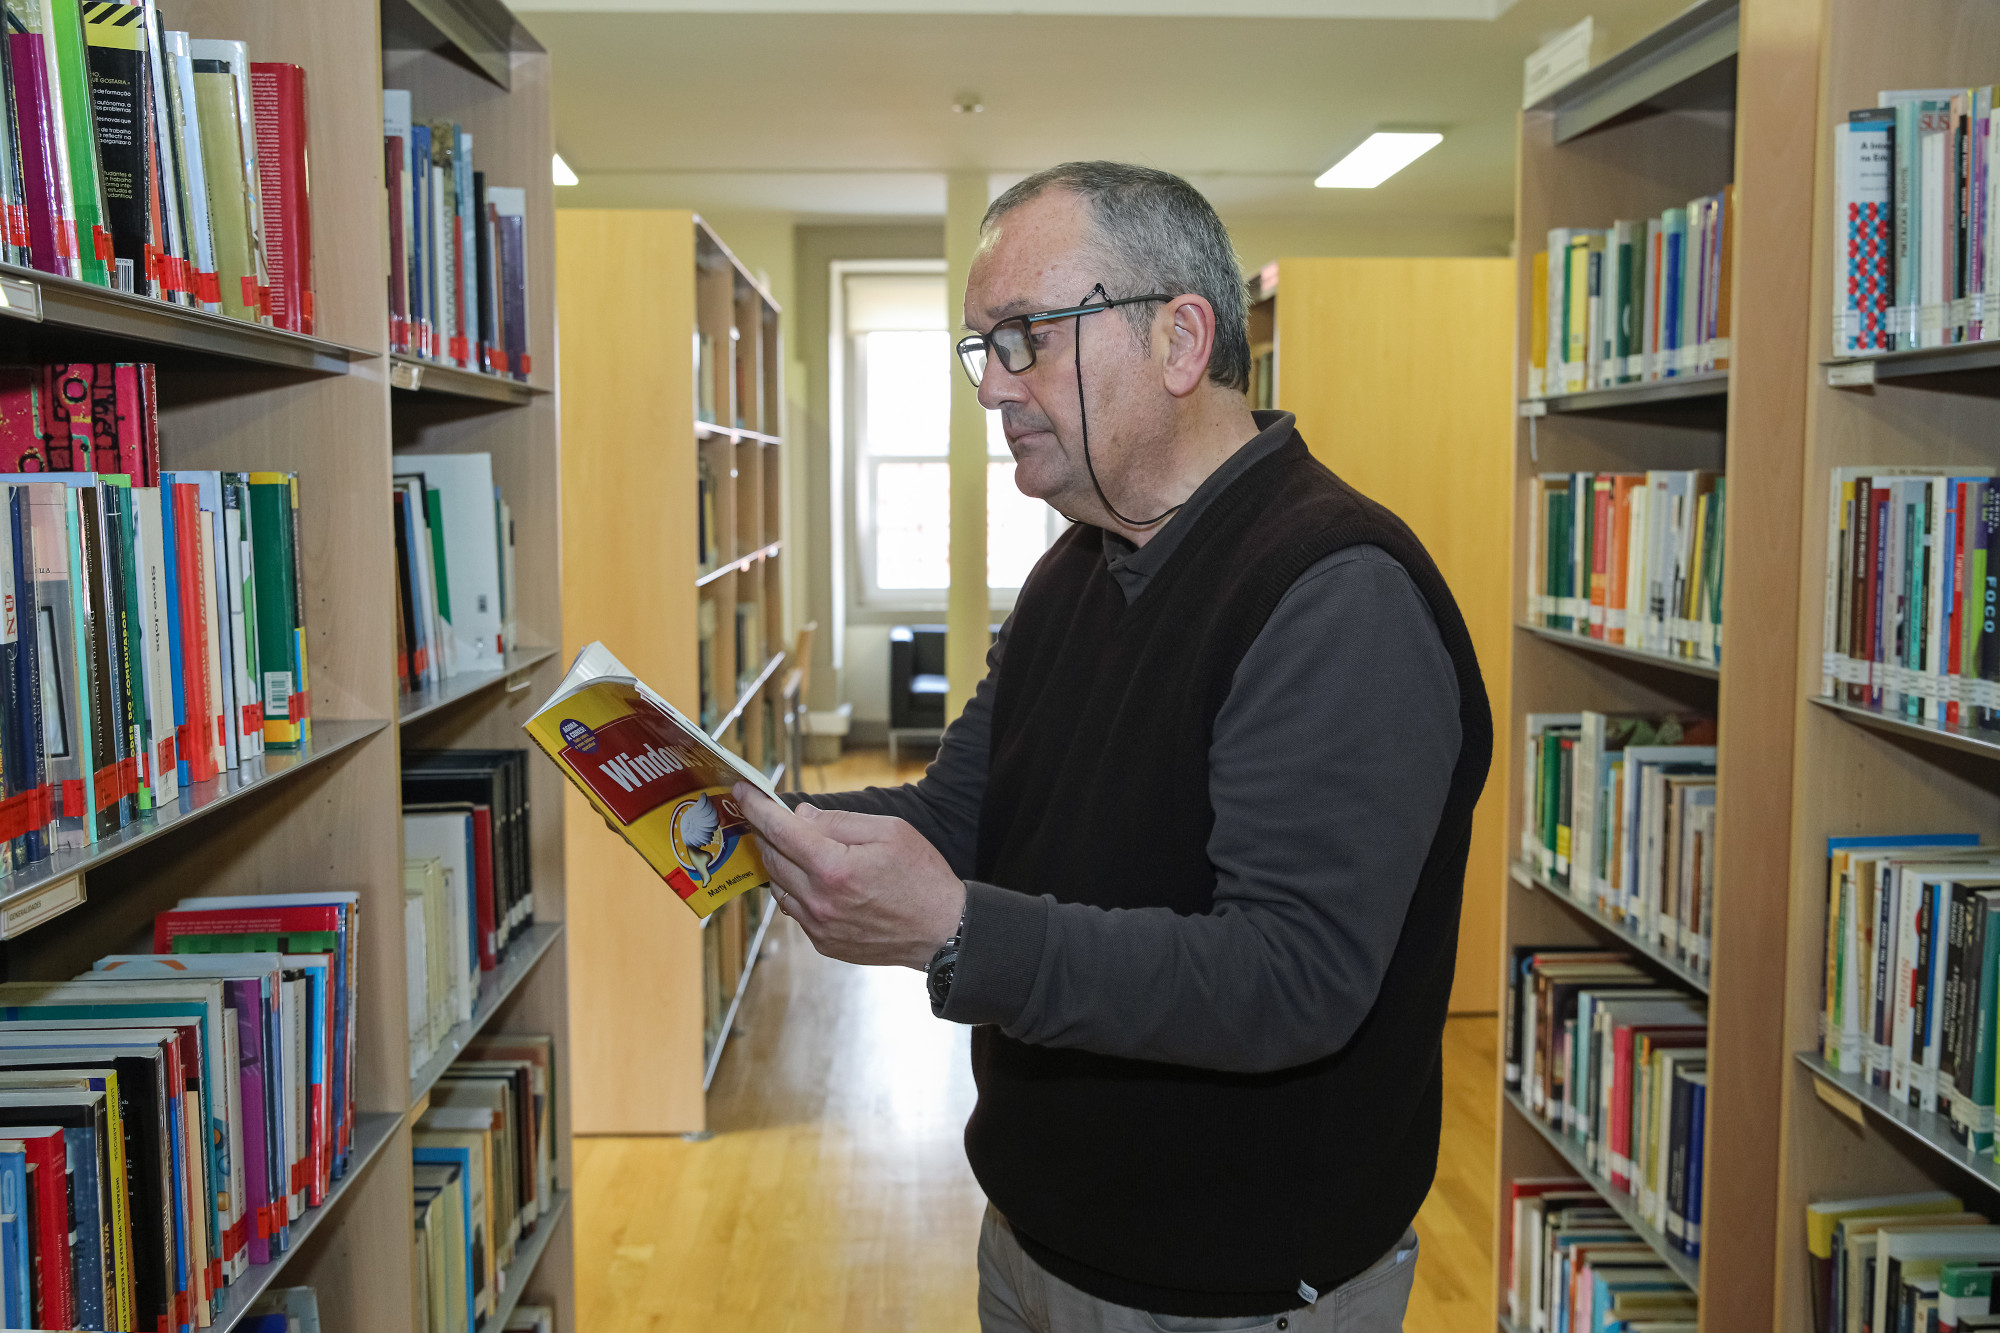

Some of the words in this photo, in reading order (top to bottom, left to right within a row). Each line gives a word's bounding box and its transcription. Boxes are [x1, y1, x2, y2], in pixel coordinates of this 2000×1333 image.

[193, 491, 207, 625] INFORMÁTICOS
[1983, 575, 1998, 633] FOCO
[121, 610, 131, 697] COMPUTADOR
[116, 678, 125, 759] onquistadores
[127, 701, 134, 721] DO
[562, 721, 579, 734] AGORA
[707, 884, 727, 898] Marty
[725, 871, 754, 887] Matthews
[9, 900, 42, 922] GENERALIDADES
